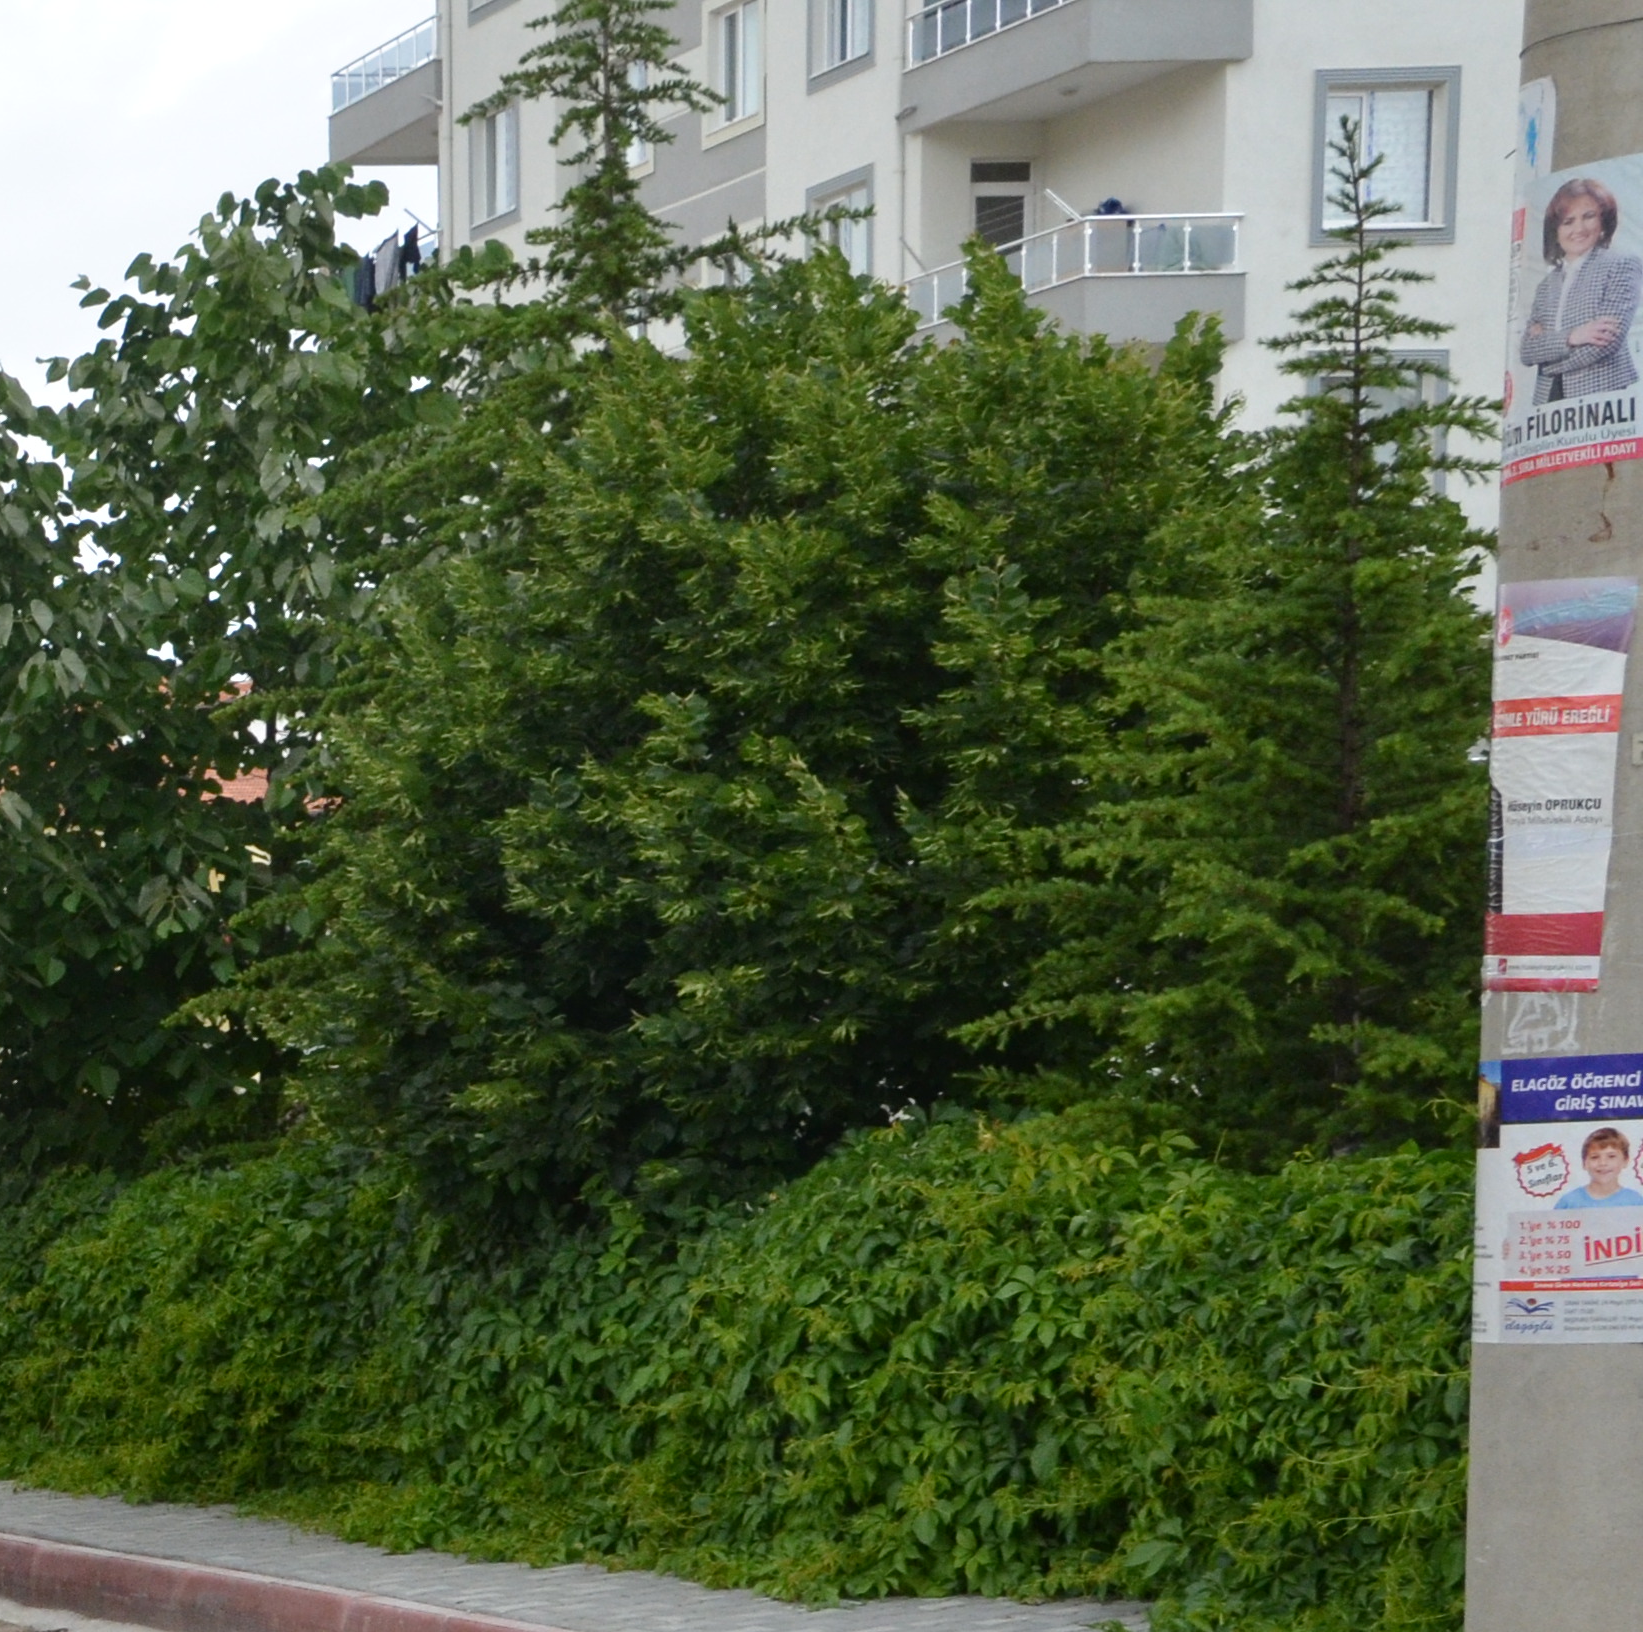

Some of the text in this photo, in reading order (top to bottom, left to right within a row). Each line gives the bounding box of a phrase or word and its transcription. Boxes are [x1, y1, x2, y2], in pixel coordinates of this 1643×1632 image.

[1526, 397, 1636, 441] FİLORİNALI
[1602, 441, 1637, 457] ADAYI
[1561, 704, 1611, 725] EREĞLİ
[1511, 1070, 1642, 1092] ELAGÖZ ÖĞRENCİ
[1555, 1094, 1596, 1113] GİRİŞ
